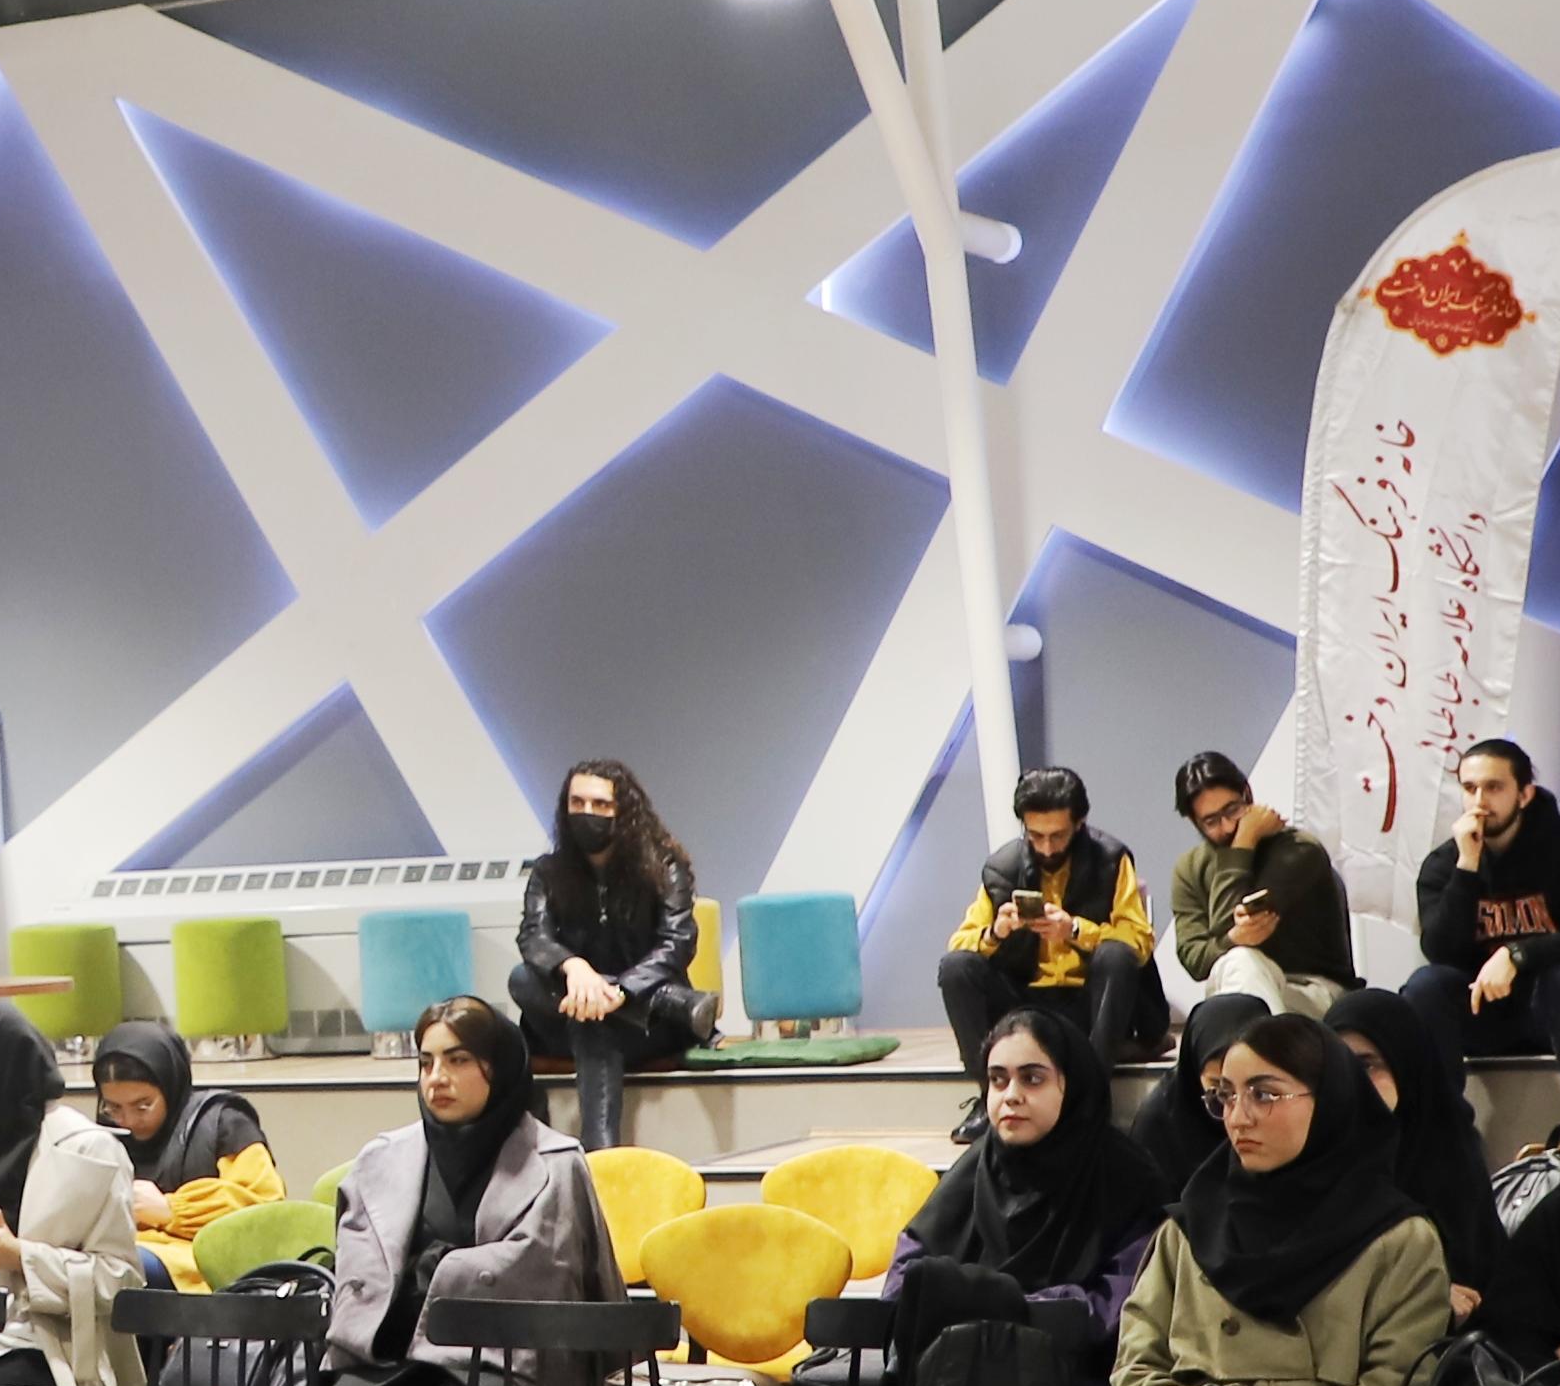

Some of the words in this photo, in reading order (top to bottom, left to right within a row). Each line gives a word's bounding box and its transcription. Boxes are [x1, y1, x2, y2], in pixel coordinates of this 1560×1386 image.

[1375, 419, 1417, 476] خانه
[1331, 475, 1418, 594] فرهنگ
[1427, 512, 1488, 593] دانشگاه
[1439, 597, 1474, 671] علامه
